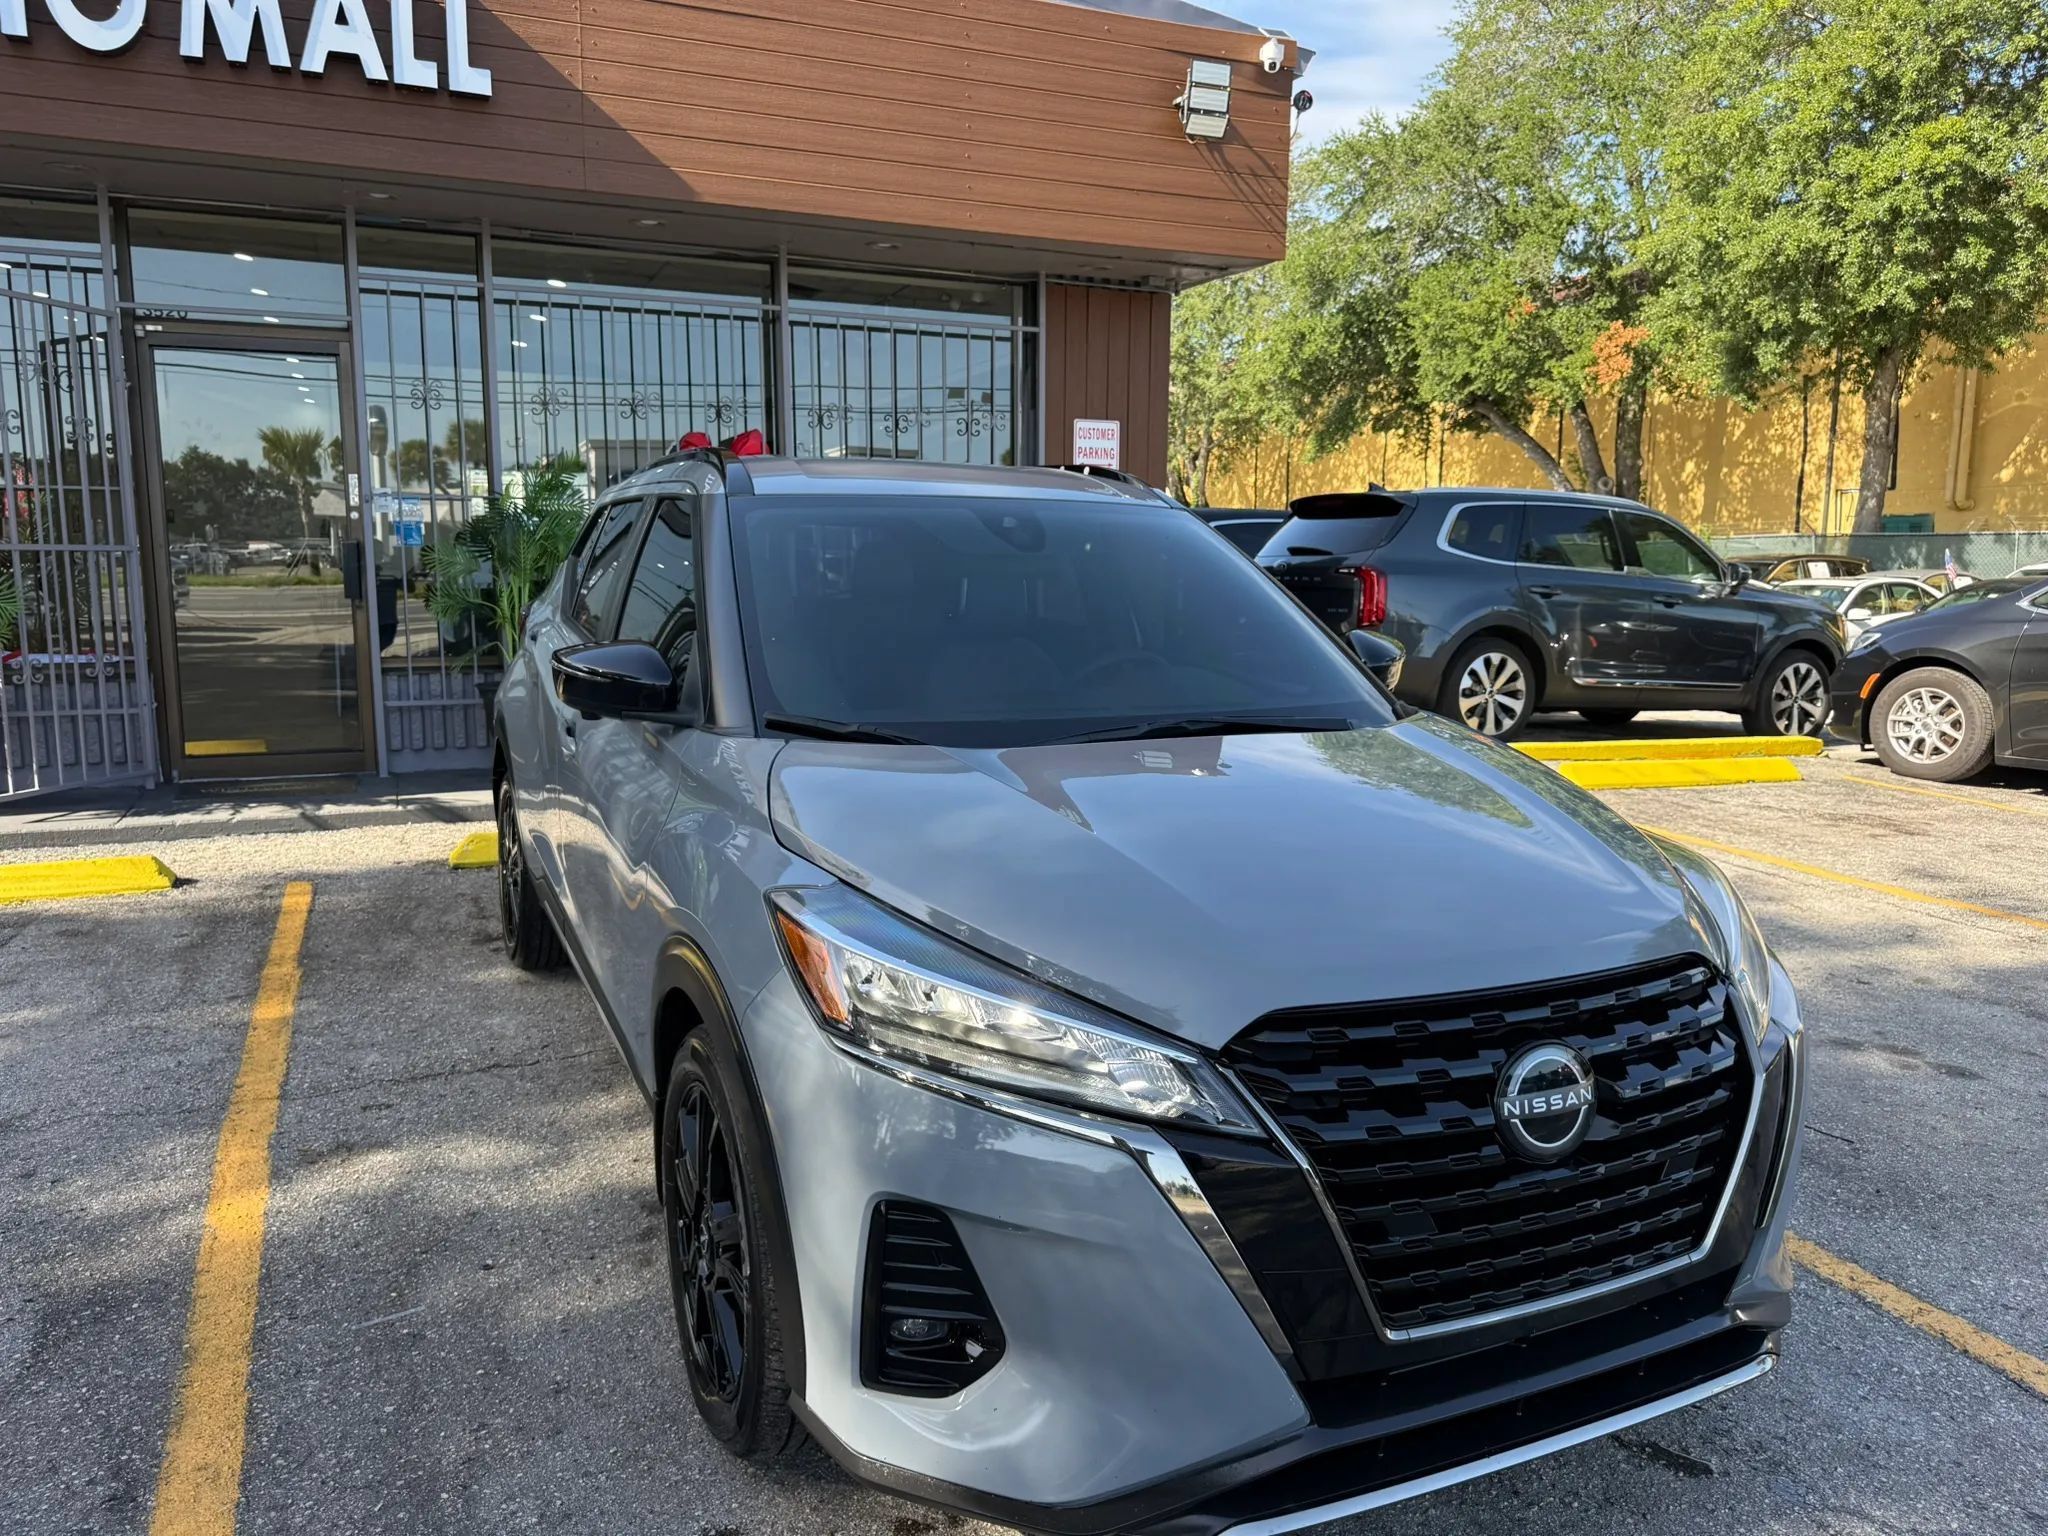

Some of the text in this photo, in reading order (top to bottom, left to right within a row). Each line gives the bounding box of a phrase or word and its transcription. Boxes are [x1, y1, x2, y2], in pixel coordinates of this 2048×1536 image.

[180, 0, 492, 97] MALL
[1077, 426, 1116, 440] CUSTOMER
[1077, 446, 1115, 460] PARKING
[1503, 1085, 1592, 1116] NISSAN
